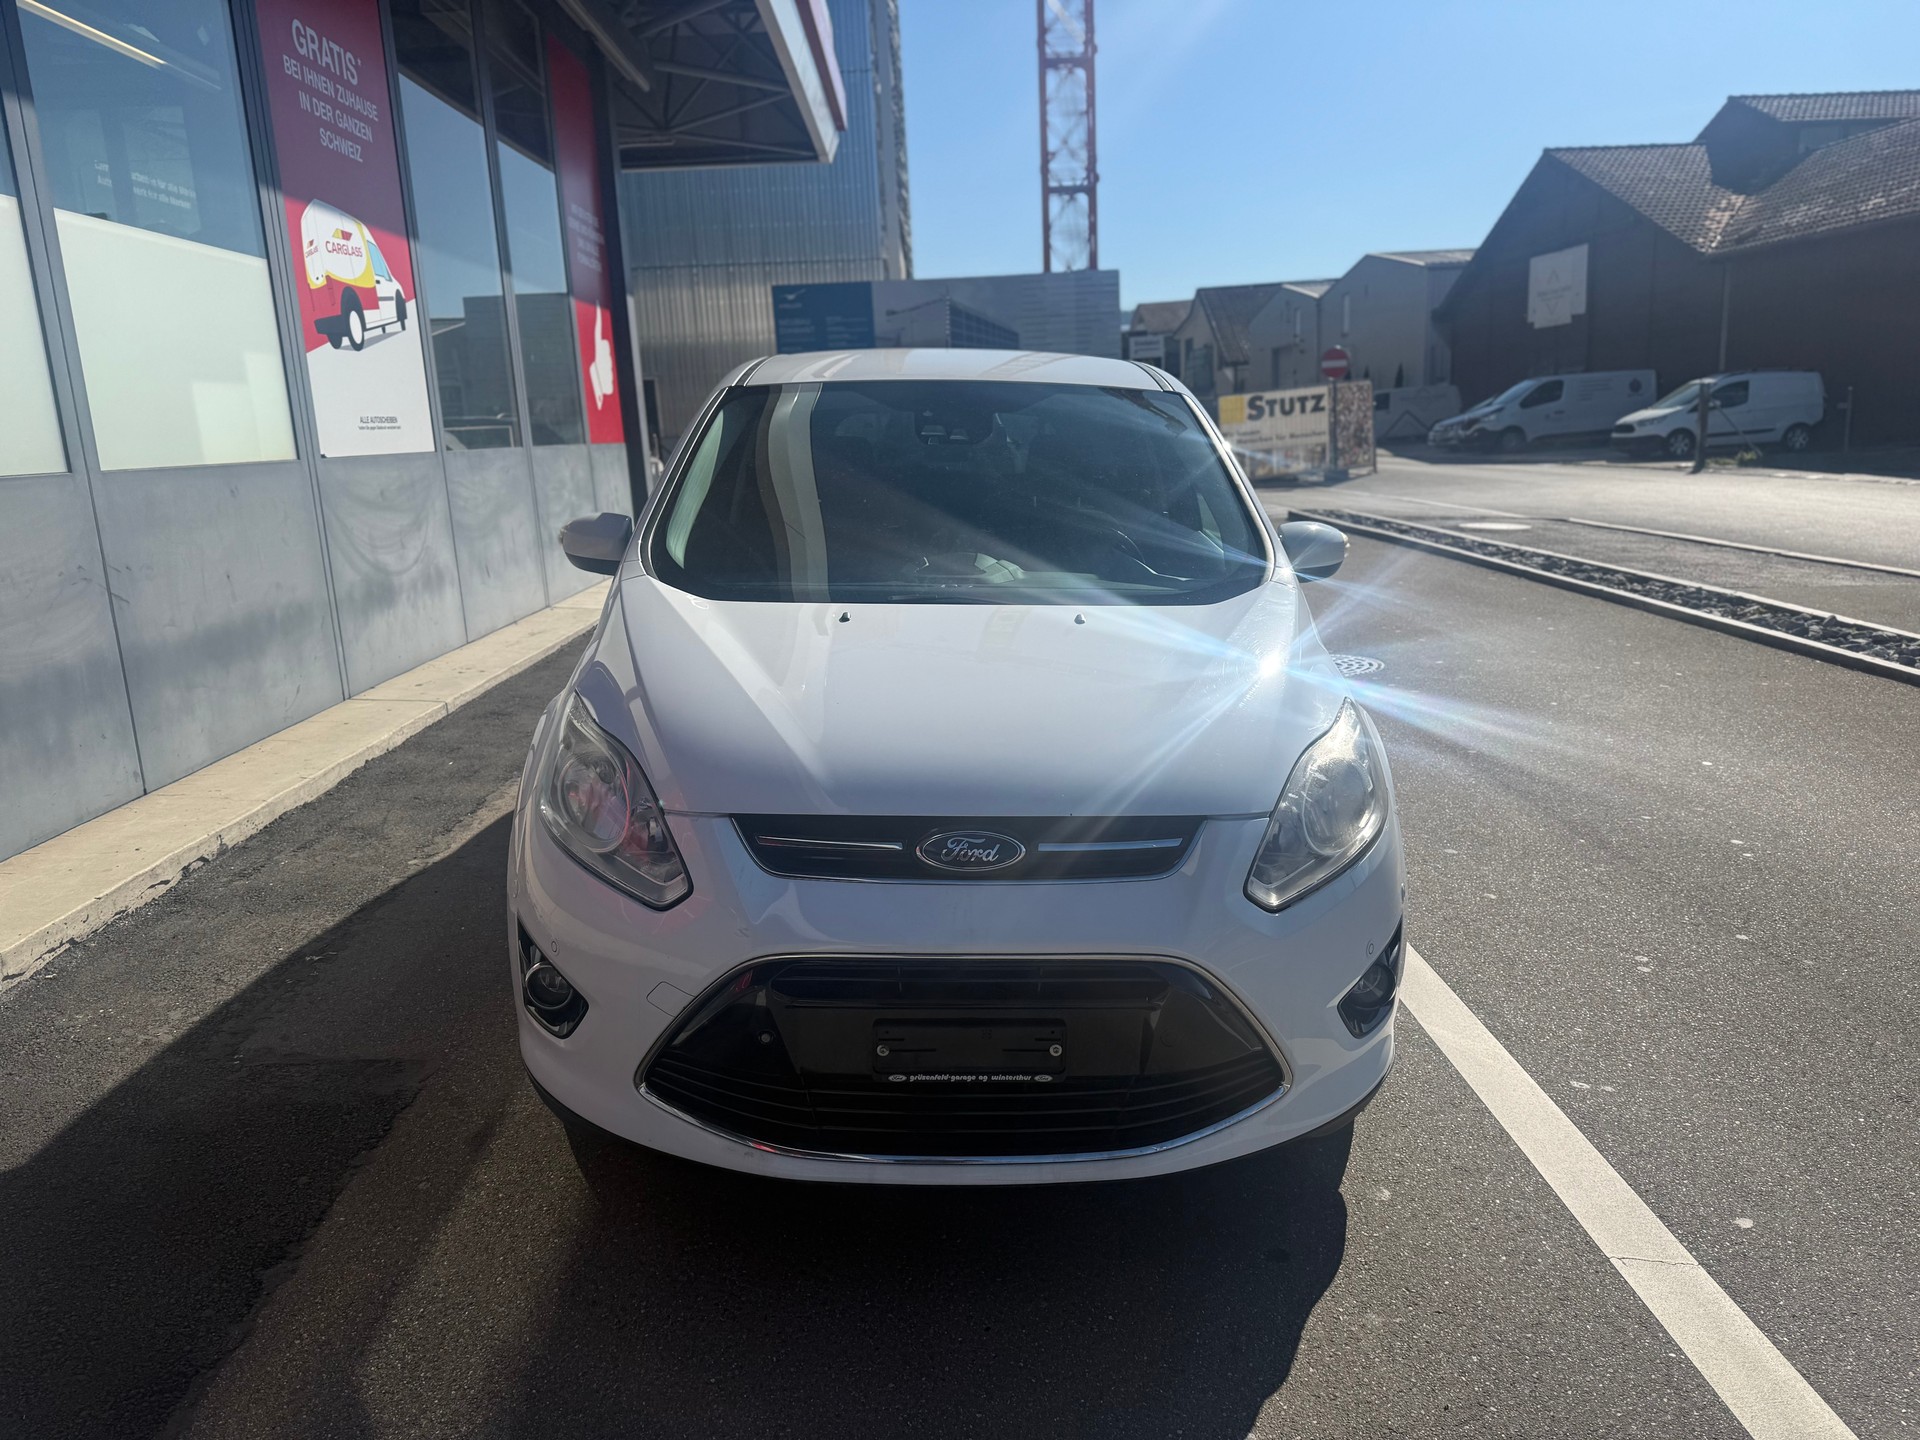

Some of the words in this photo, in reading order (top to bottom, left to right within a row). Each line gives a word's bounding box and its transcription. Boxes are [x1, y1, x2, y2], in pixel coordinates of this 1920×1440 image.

[282, 54, 302, 80] BEI
[303, 65, 335, 98] IHNEN
[335, 84, 379, 121] ZUHAUSE
[299, 90, 311, 113] IN
[312, 97, 334, 123] DER
[335, 109, 374, 143] GANZEN
[319, 128, 363, 162] SCHWEIZ
[325, 240, 363, 258] CARGLASS
[360, 416, 370, 424] ALLE
[1247, 393, 1326, 421] STUTZ
[941, 837, 1000, 862] Ford
